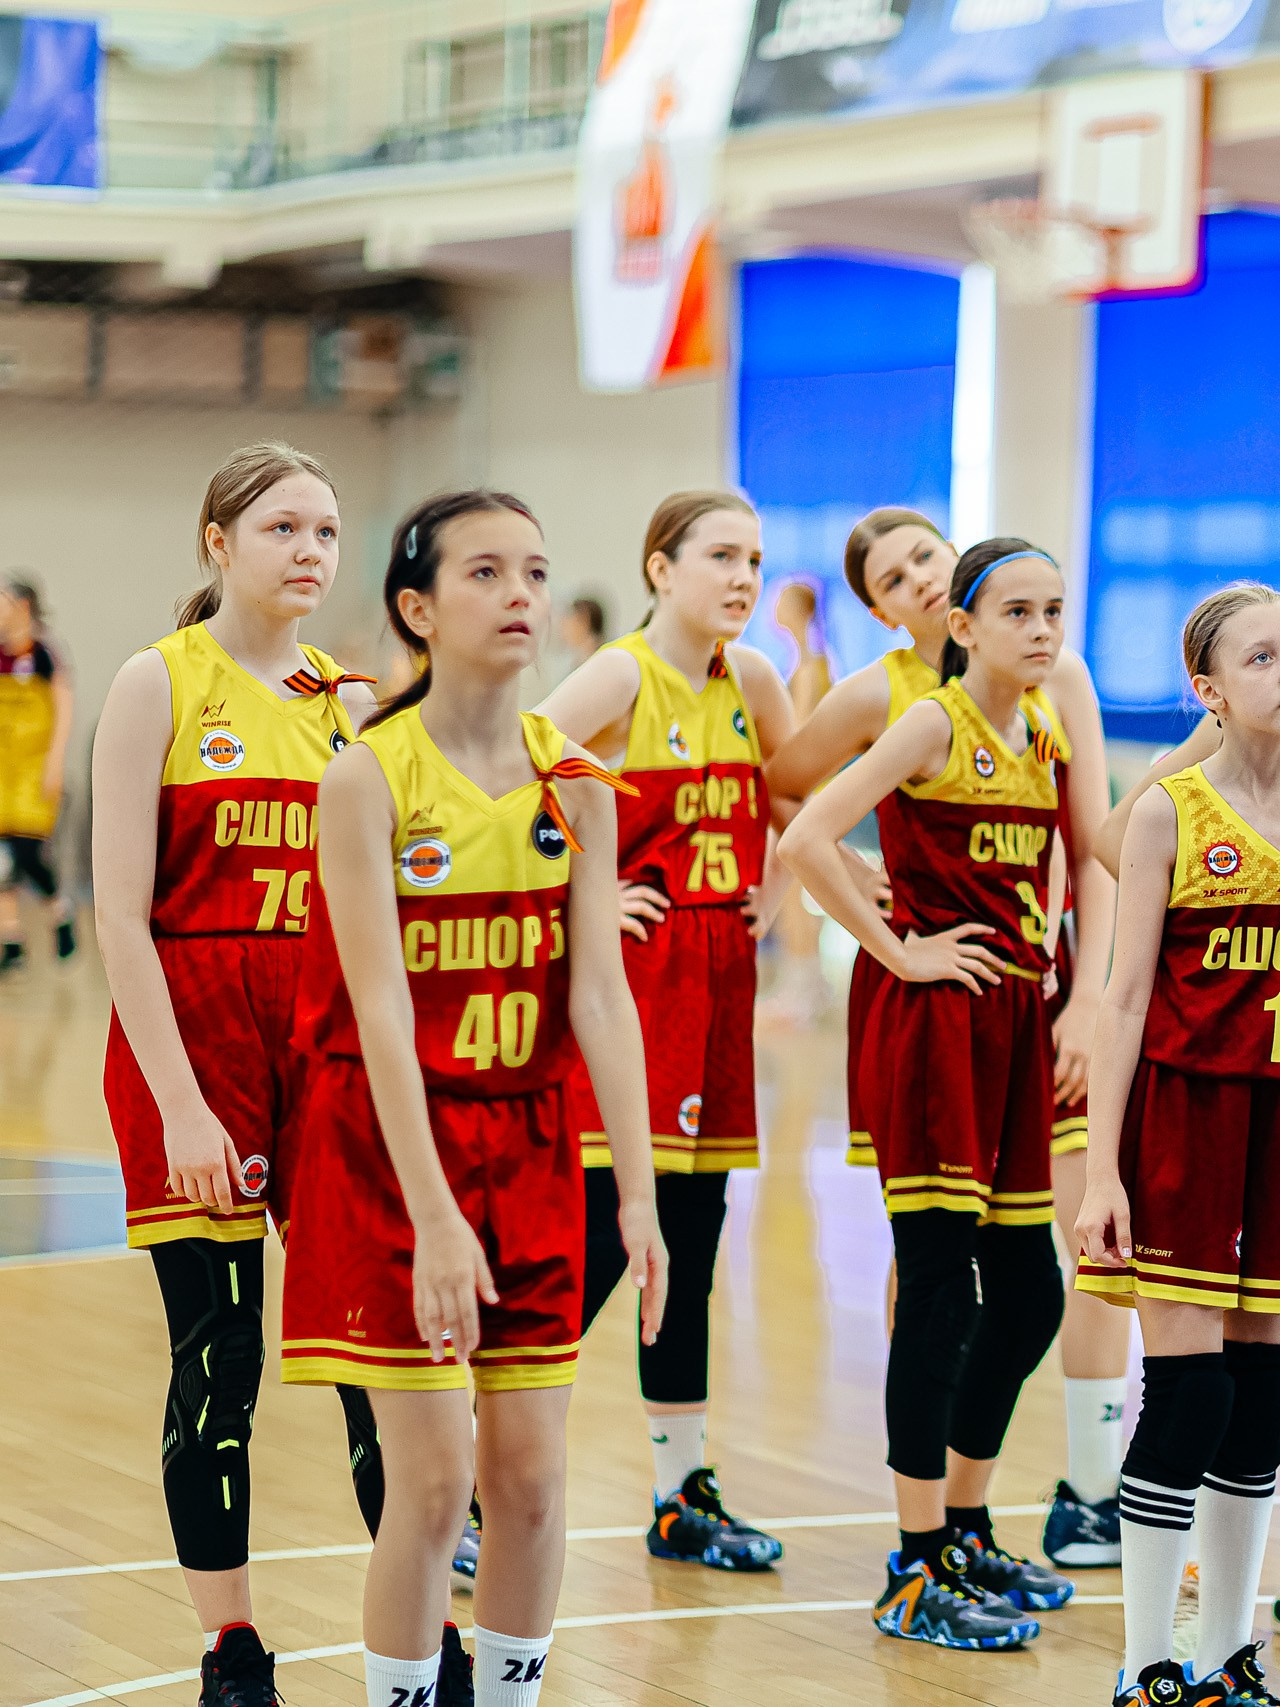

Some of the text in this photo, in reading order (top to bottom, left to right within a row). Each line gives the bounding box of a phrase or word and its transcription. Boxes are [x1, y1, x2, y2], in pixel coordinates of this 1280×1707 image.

[200, 744, 244, 758] НАДЕЖДА
[201, 720, 232, 728] WINRISE
[686, 829, 741, 894] 75
[252, 868, 312, 933] 79
[1015, 880, 1048, 945] 3
[1203, 887, 1249, 898] 2K SPORT
[403, 915, 543, 973] СШОР
[453, 990, 540, 1071] 40
[1143, 1247, 1174, 1258] SPORT
